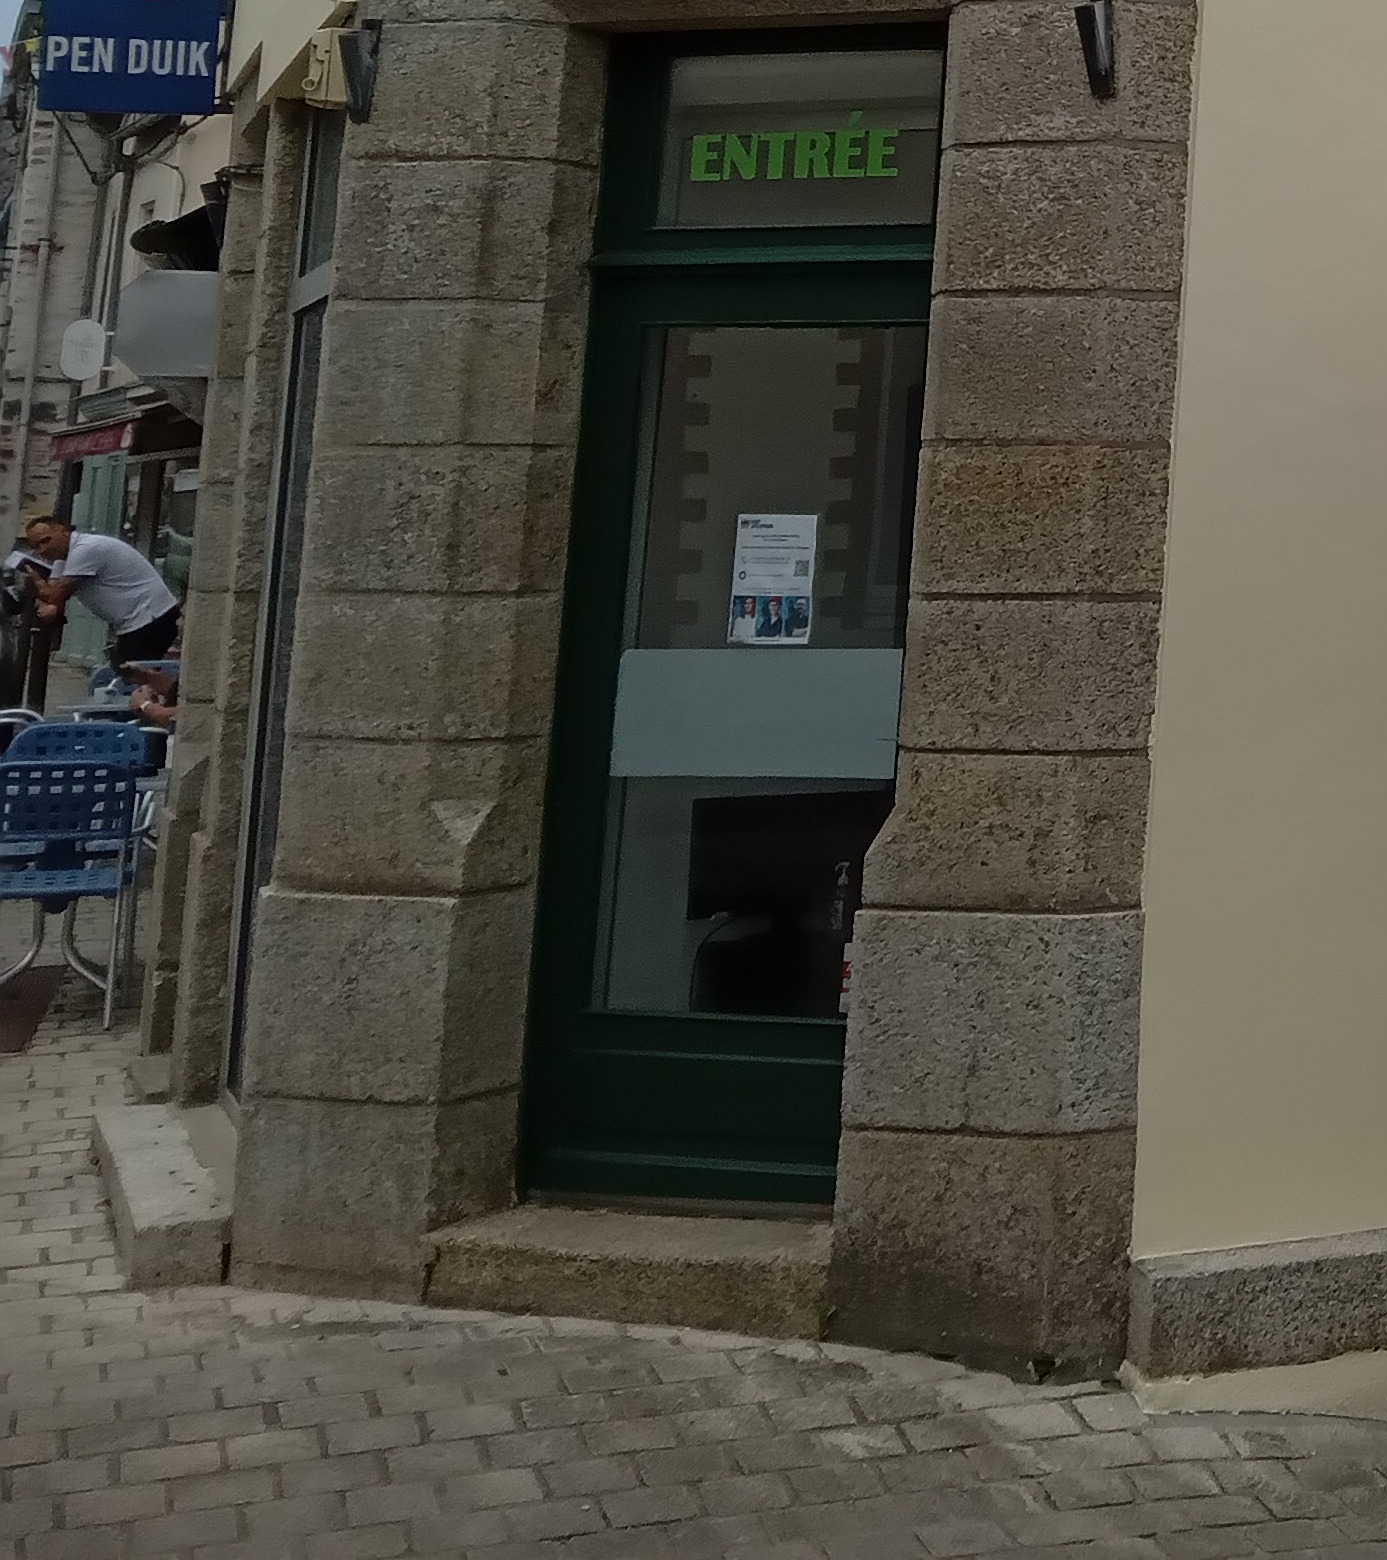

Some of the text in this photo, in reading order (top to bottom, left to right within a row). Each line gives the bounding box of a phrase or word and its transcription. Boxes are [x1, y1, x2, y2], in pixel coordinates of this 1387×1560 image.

[45, 35, 210, 77] PEN DUIK
[690, 110, 899, 182] ENTRÉE
